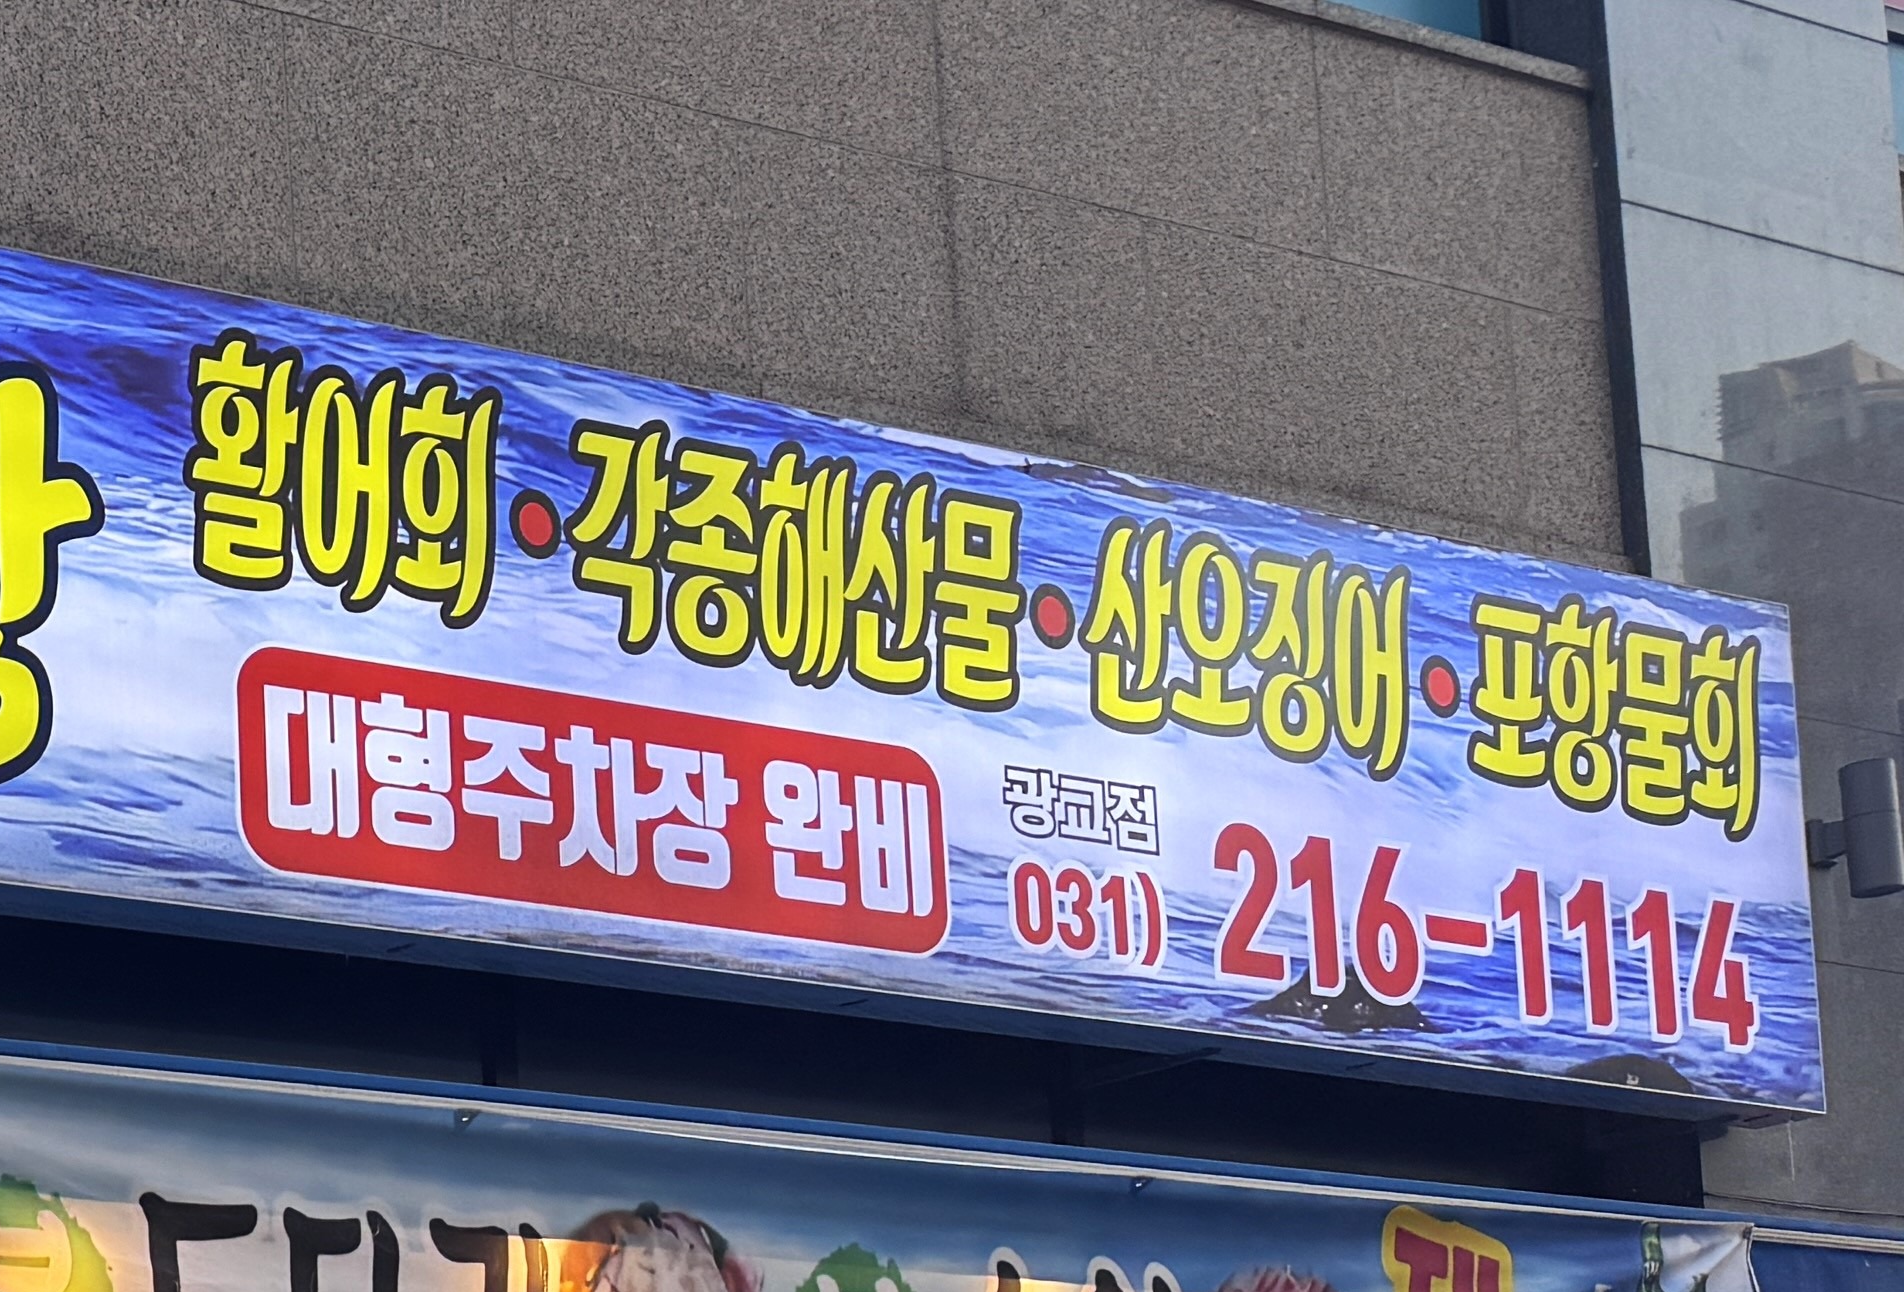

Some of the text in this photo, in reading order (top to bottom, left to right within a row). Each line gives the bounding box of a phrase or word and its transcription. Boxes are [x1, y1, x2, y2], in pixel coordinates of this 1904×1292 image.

[188, 328, 1765, 842] 활어회 각종해산물 산오징어 포항물회
[262, 678, 936, 921] 대형주차장 완비
[1001, 760, 1162, 859] 광교점
[1009, 819, 1762, 1054] 031) 216-1114
